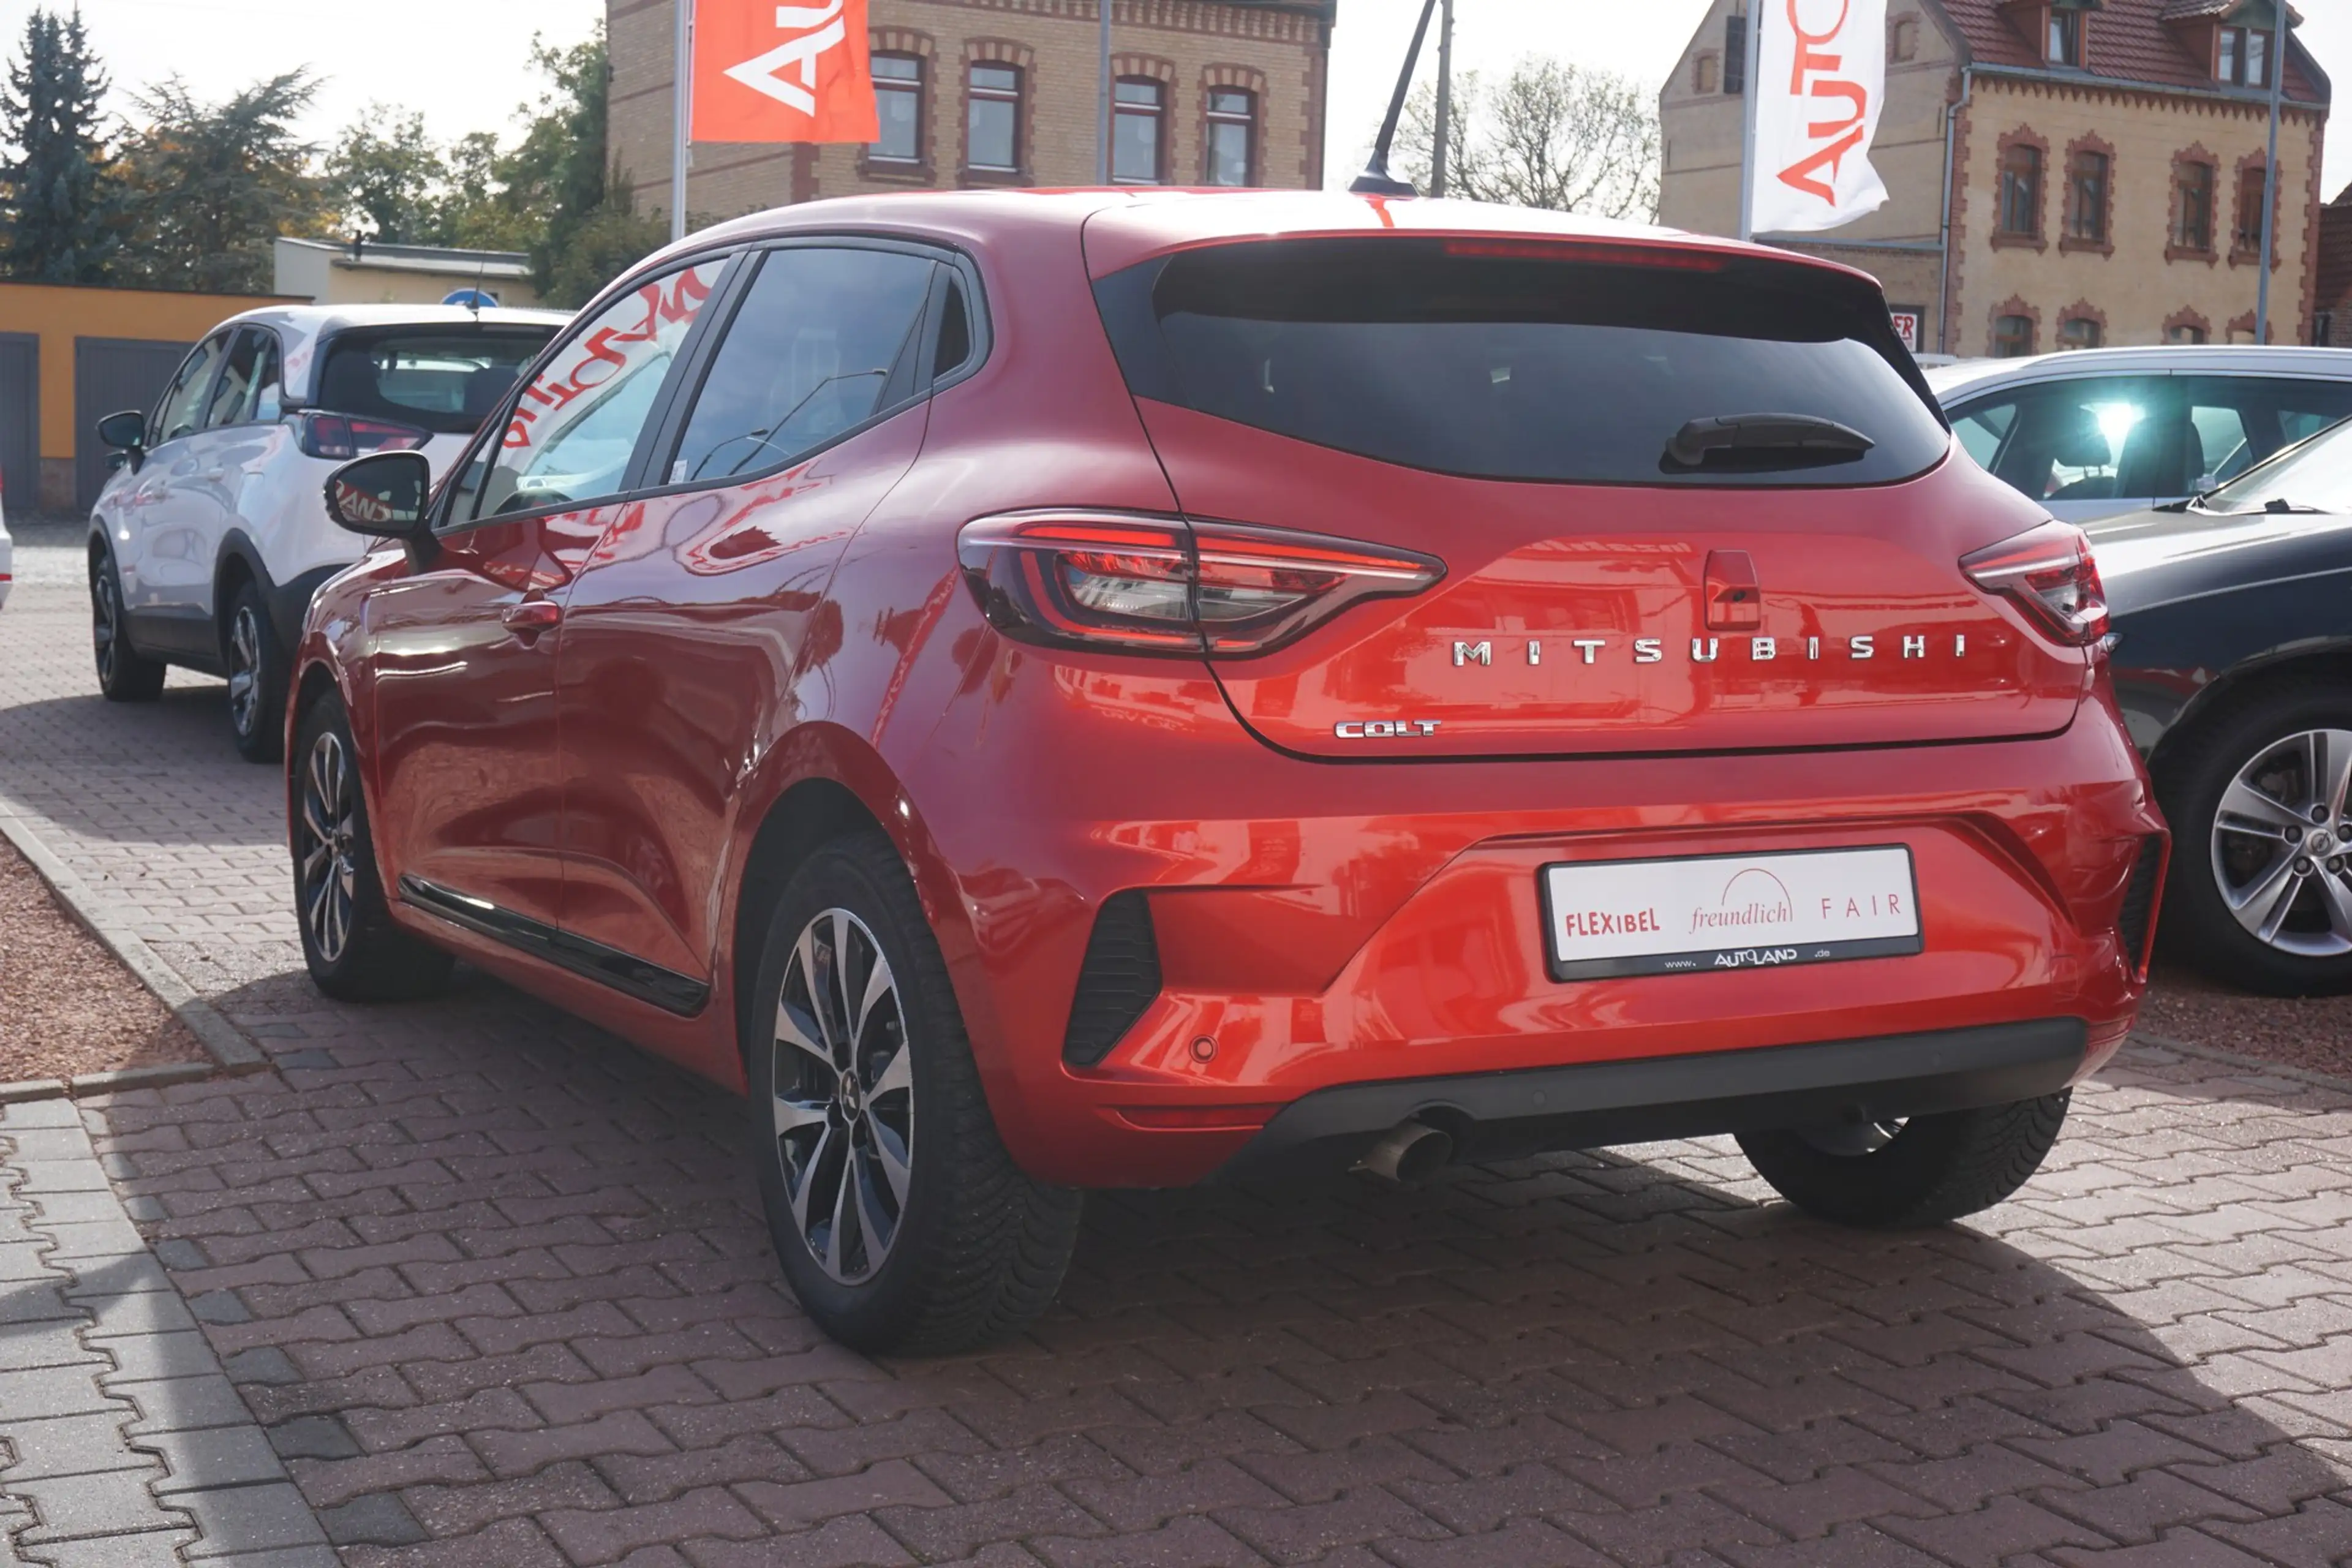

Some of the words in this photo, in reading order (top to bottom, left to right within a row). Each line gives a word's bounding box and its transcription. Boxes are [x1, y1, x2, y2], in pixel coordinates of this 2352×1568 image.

[1453, 634, 1965, 666] MITSUBISHI
[1335, 720, 1441, 739] COLT
[1566, 908, 1660, 937] FLEXIBEL
[1689, 902, 1787, 935] freundlich
[1821, 894, 1901, 919] FAIR
[1714, 949, 1798, 968] AUTOLAND
